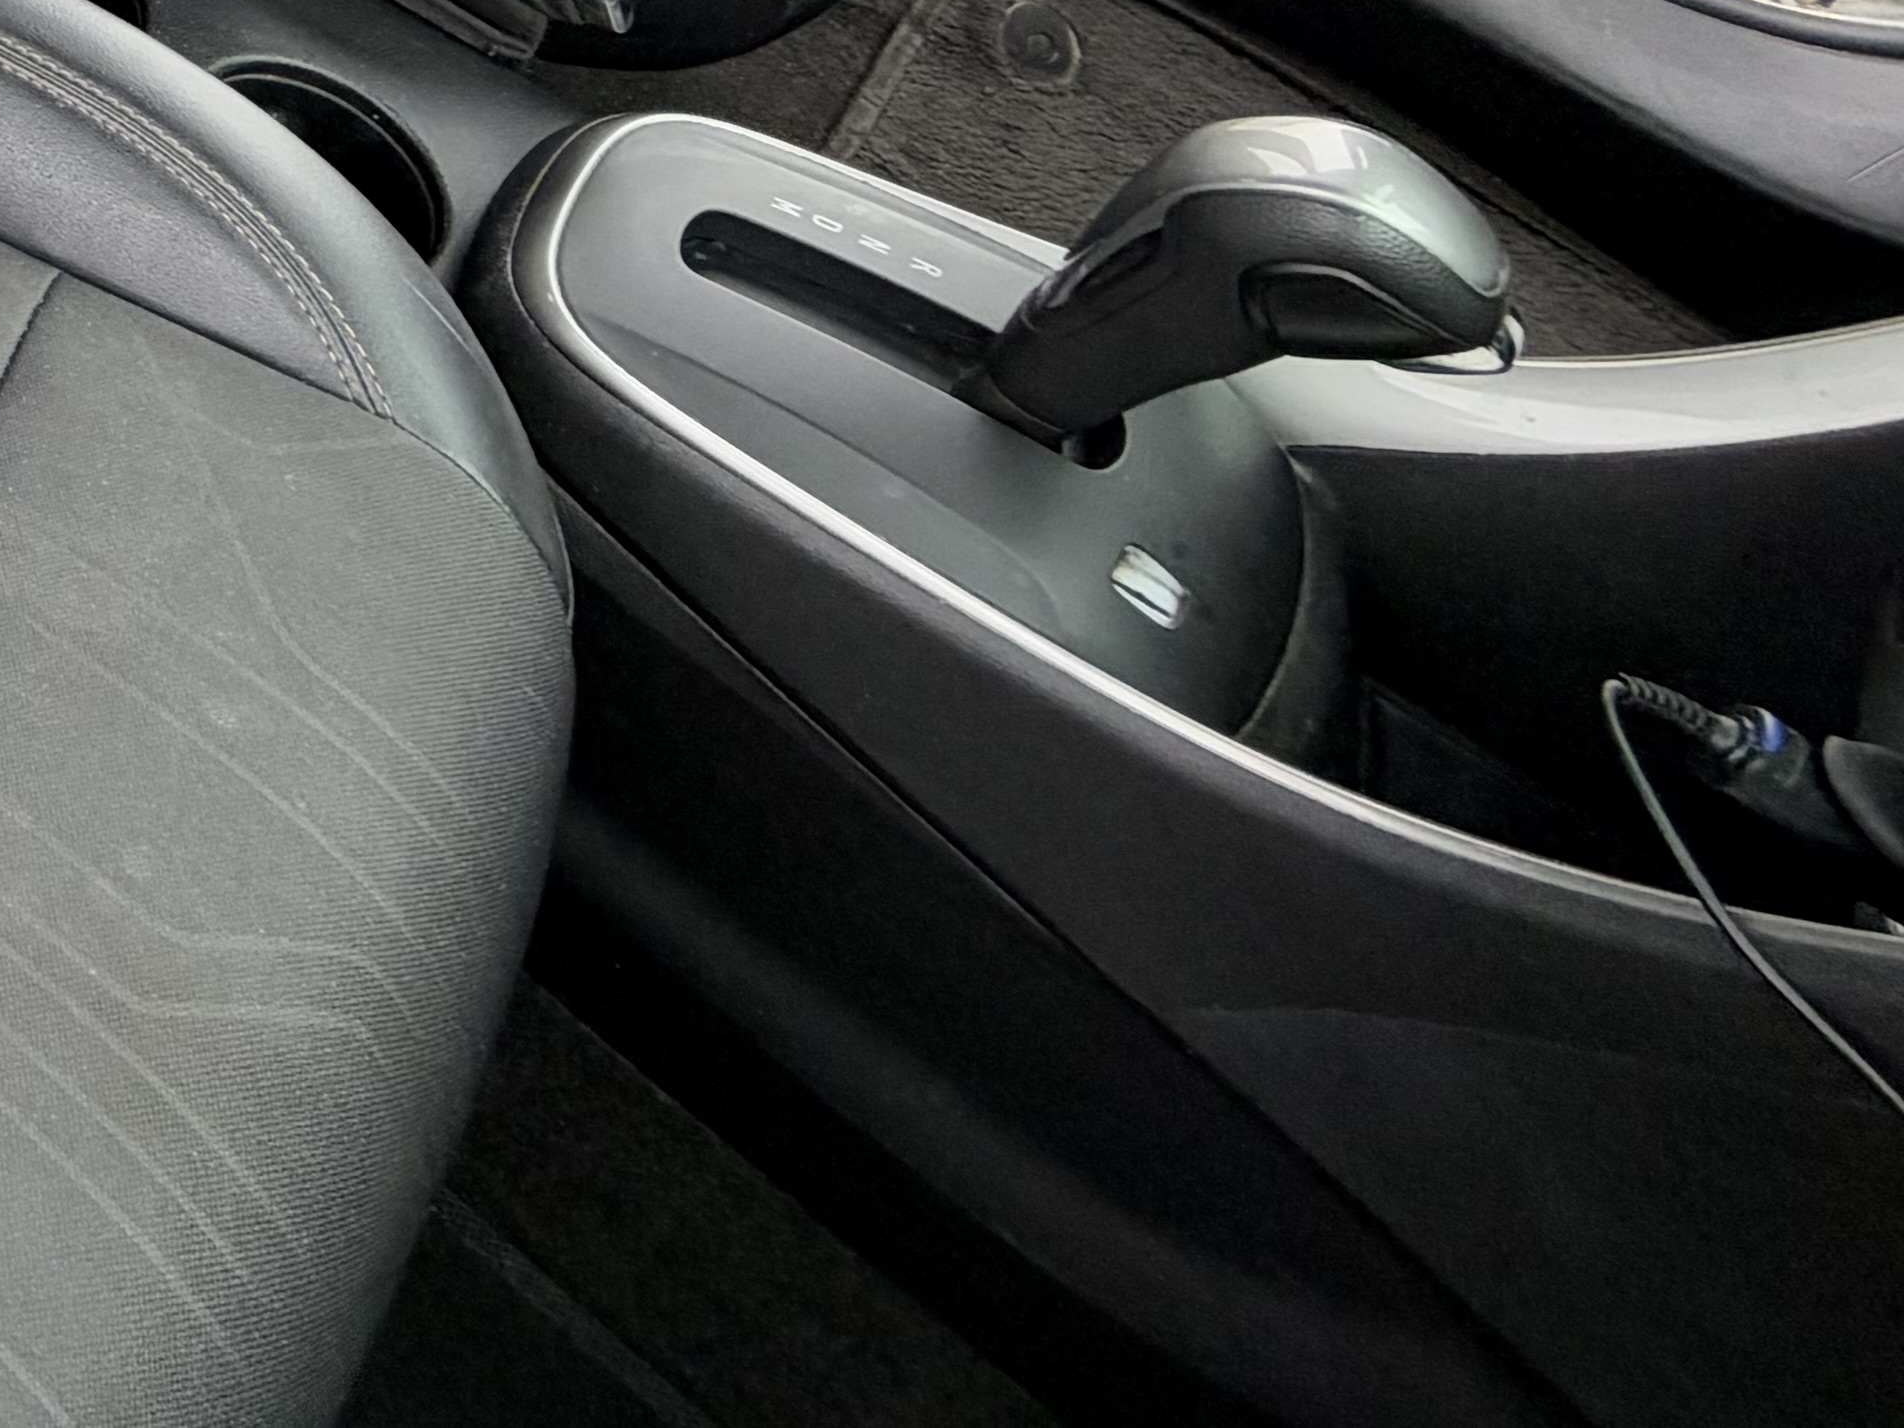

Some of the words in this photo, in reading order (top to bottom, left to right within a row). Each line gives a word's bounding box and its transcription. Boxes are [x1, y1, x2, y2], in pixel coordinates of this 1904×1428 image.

[770, 197, 804, 217] M
[812, 214, 844, 233] D
[858, 234, 891, 255] N
[909, 257, 943, 278] R
